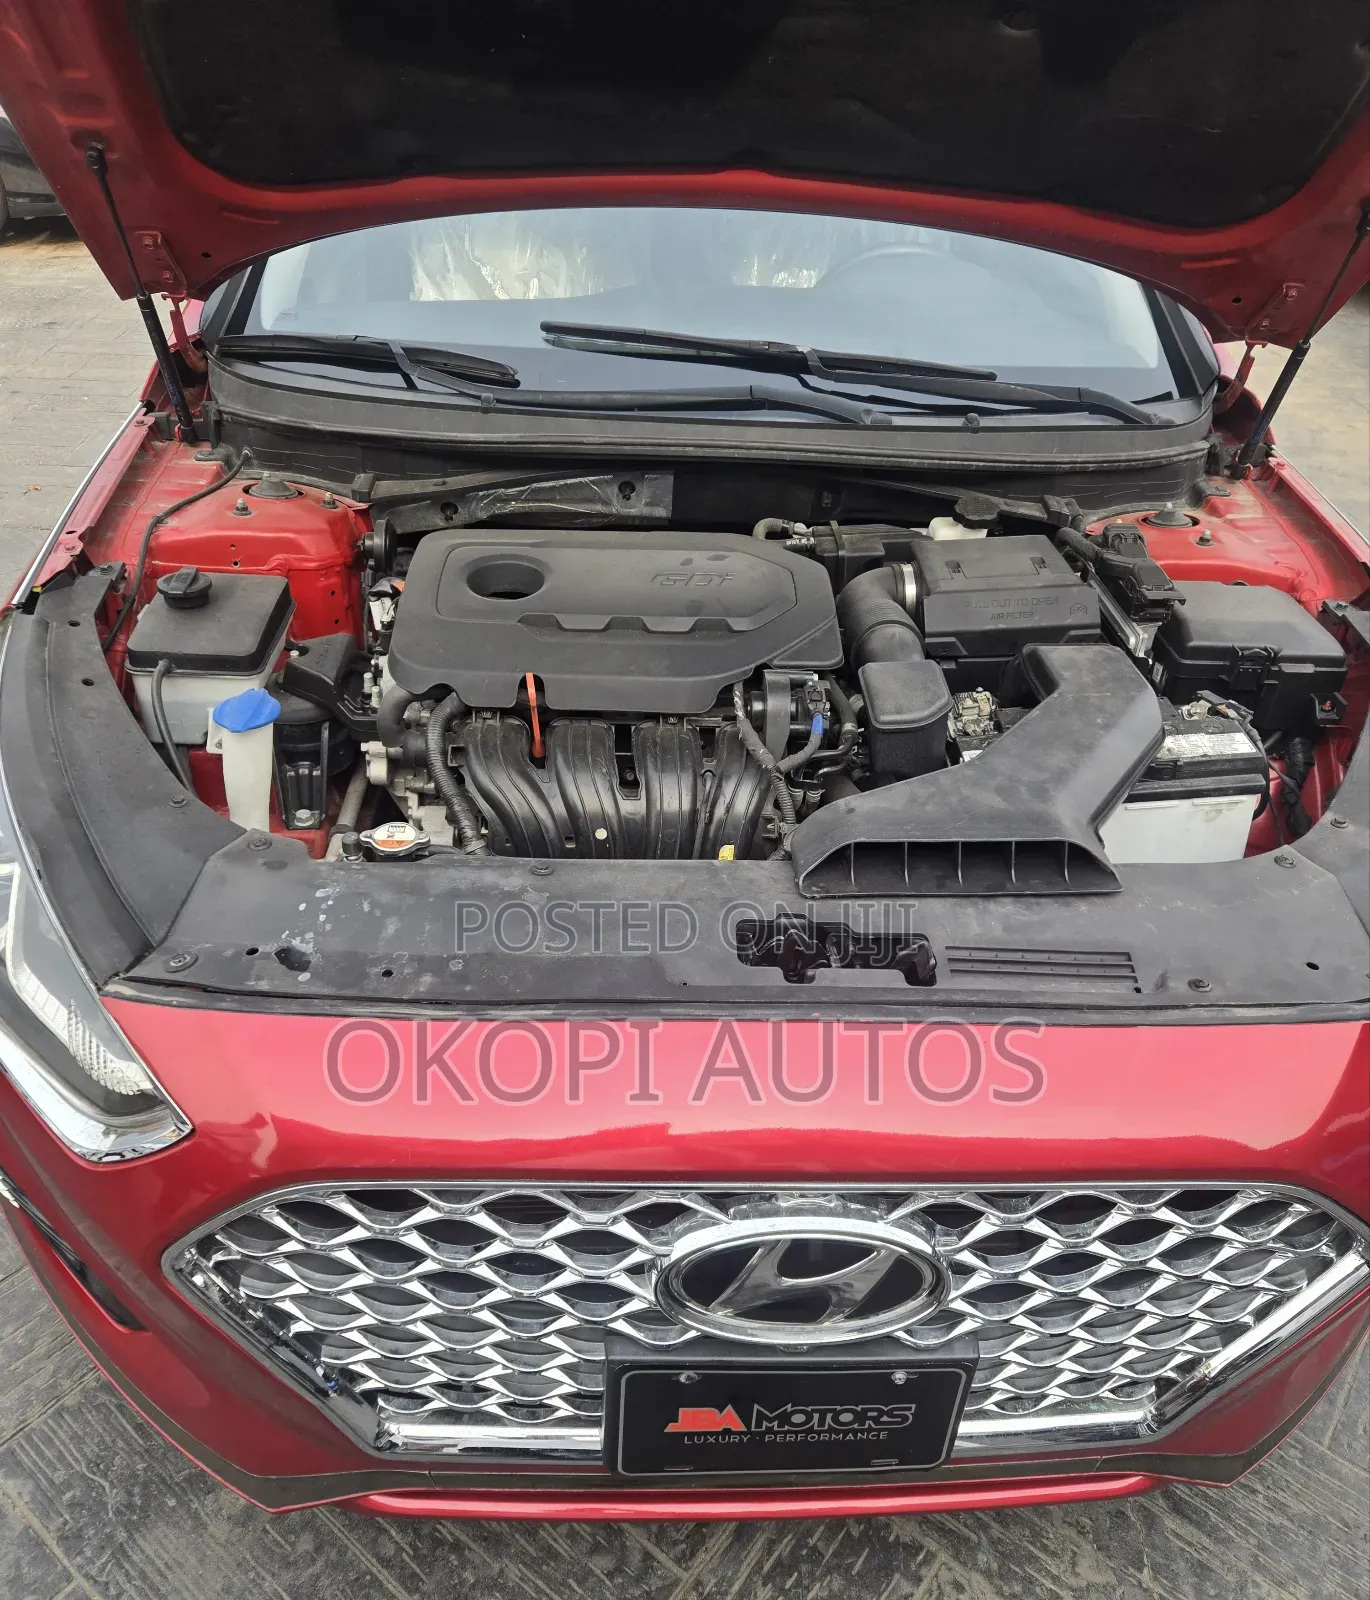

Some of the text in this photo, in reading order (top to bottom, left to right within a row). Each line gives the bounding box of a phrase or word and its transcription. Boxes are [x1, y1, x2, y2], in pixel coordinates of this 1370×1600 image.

[963, 595, 1060, 610] PULL OUT TO OPEN
[990, 611, 1034, 620] AIR FILTER
[663, 1403, 916, 1432] JBA MOTORS
[684, 1431, 888, 1444] LUXURY PERFORMANCE
